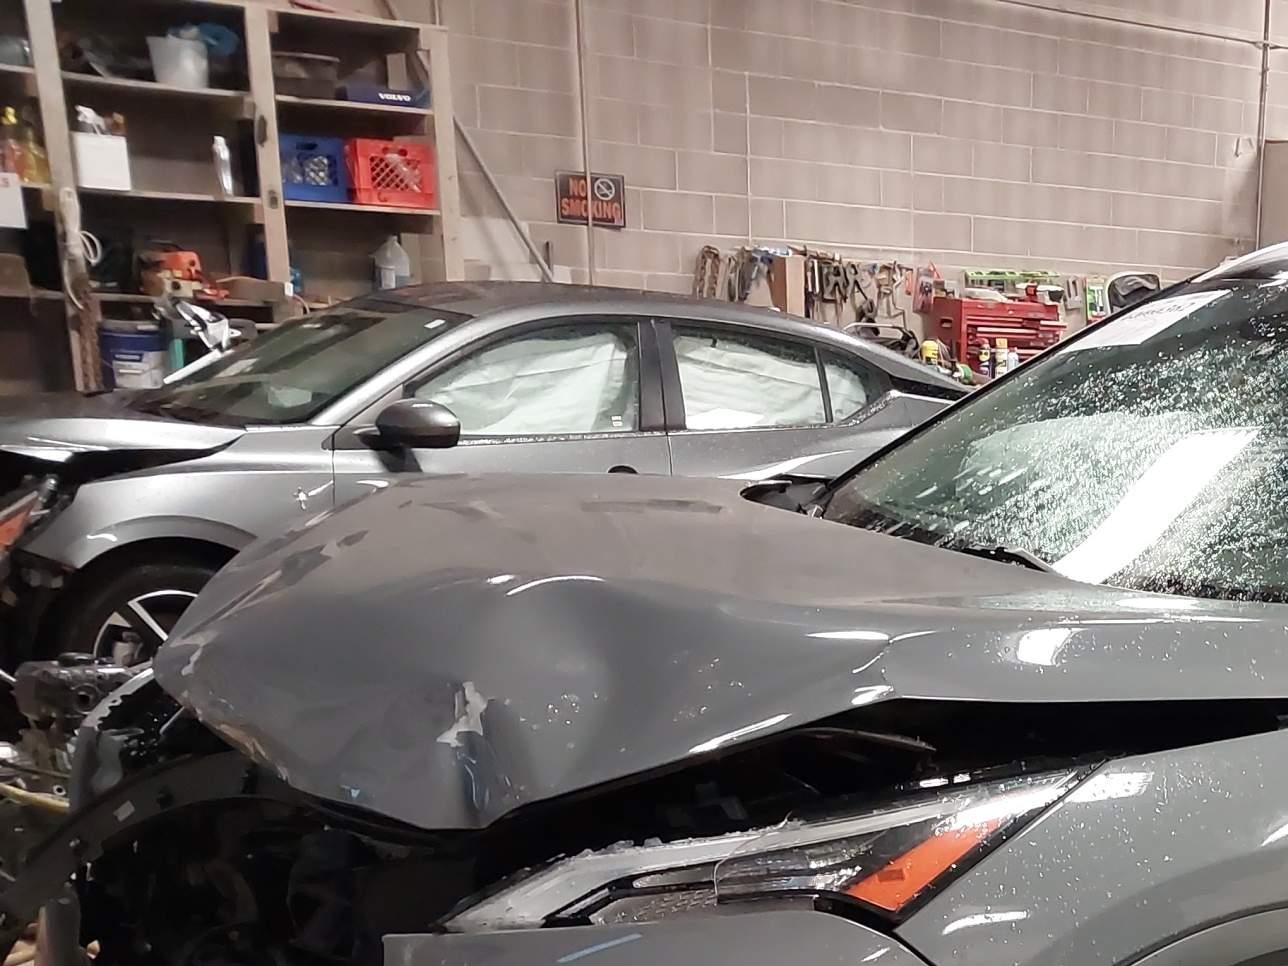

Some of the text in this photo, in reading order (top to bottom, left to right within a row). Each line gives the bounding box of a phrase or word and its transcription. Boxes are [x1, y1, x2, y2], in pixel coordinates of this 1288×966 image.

[378, 92, 412, 102] VOLVO
[568, 175, 588, 198] NO
[561, 198, 622, 220] SMOKING
